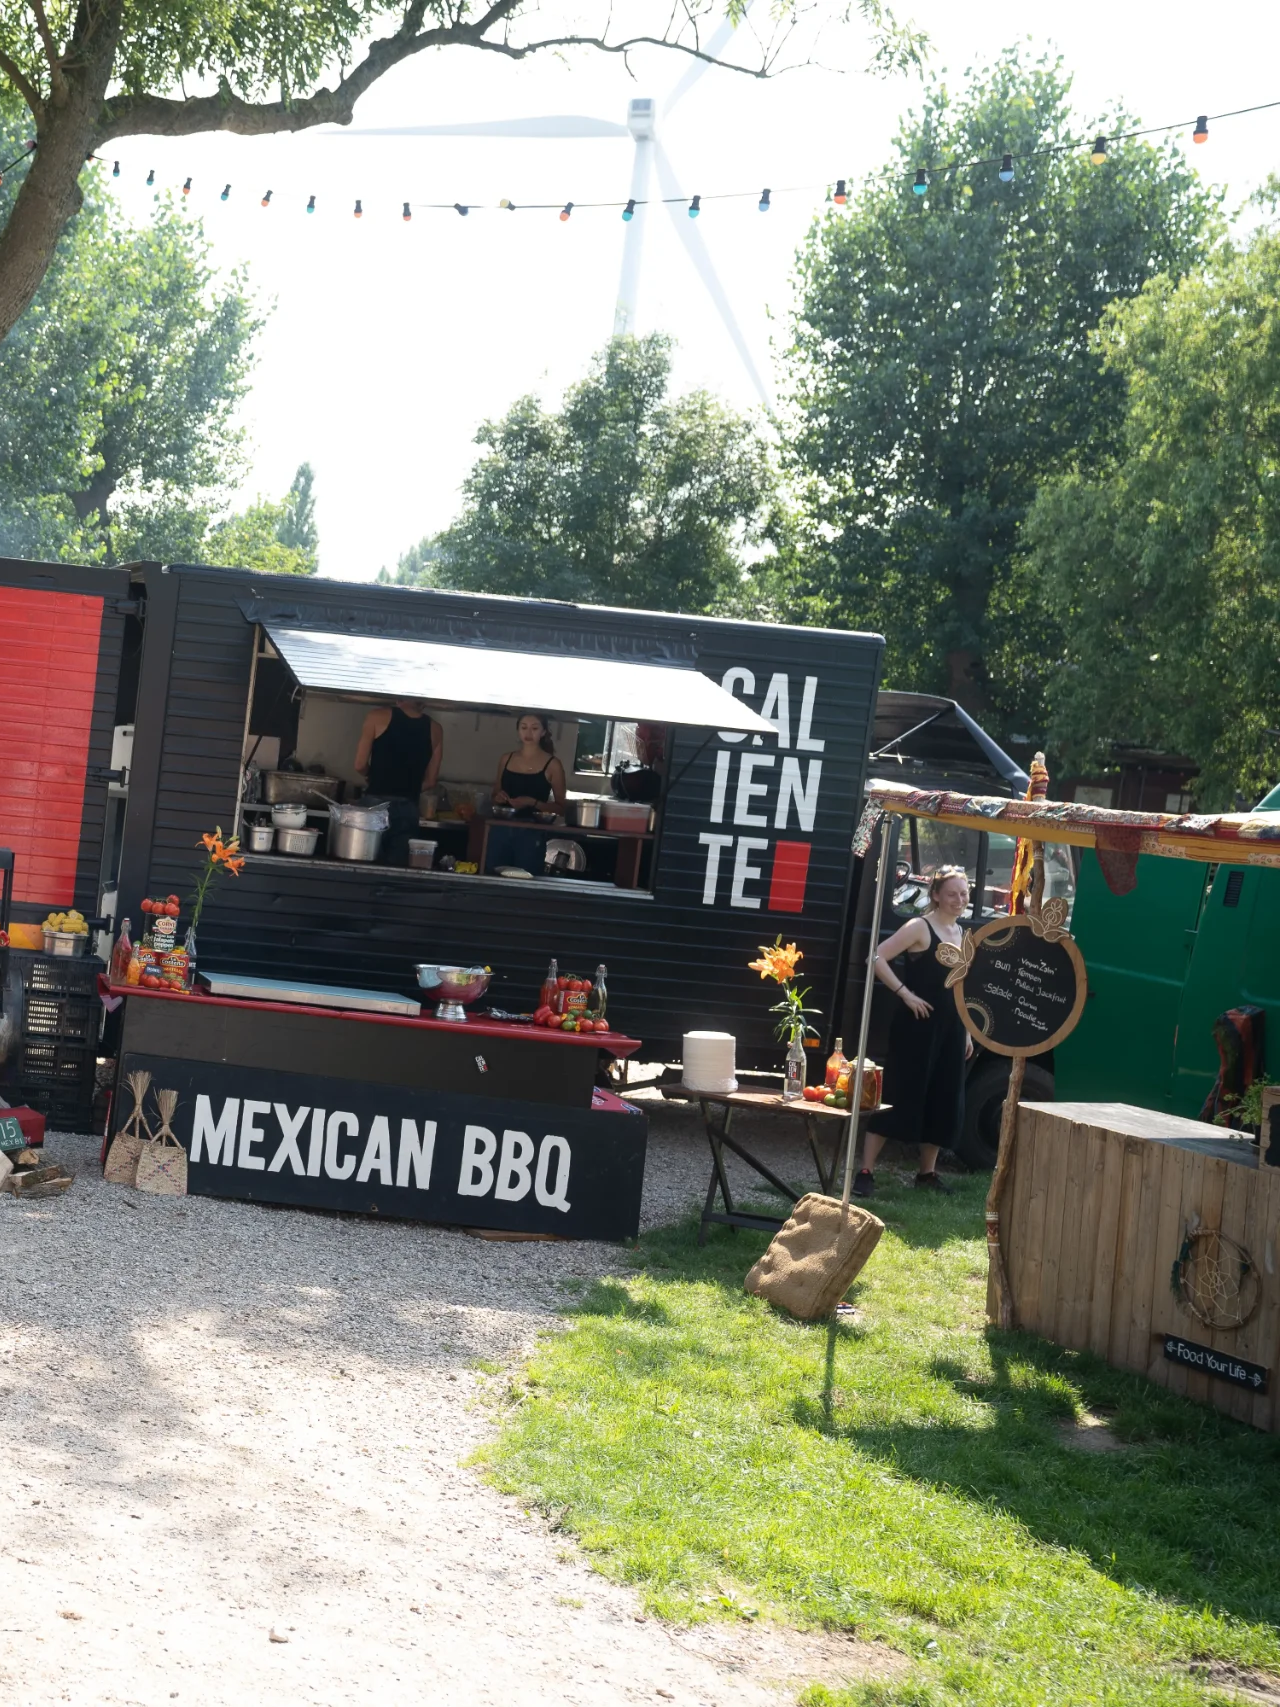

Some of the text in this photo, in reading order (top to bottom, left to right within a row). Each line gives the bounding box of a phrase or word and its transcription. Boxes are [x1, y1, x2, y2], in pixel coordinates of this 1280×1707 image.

[710, 750, 822, 832] IEN
[698, 832, 769, 909] TE
[984, 982, 1012, 1000] Salade
[994, 959, 1011, 972] Bun
[189, 1093, 572, 1213] MEXICAN BBQ
[1177, 1342, 1247, 1380] Food Your Life
